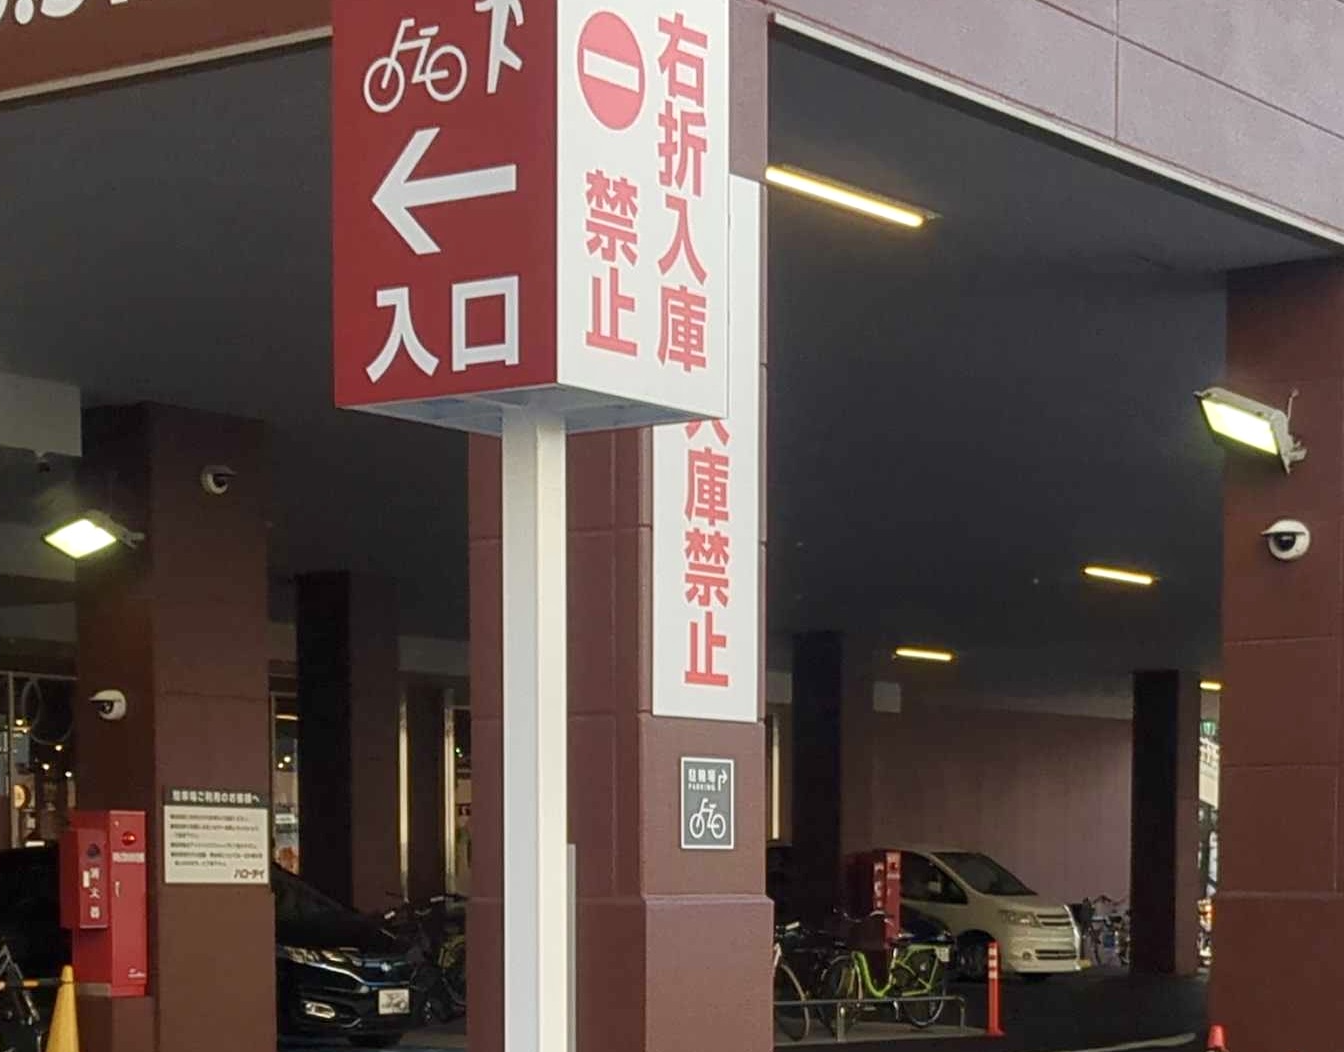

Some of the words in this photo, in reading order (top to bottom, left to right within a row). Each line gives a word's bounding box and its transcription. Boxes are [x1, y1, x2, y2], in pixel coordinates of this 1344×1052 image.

[584, 168, 639, 361] 禁止
[656, 13, 709, 375] 右折入庫
[364, 274, 520, 383] 入口
